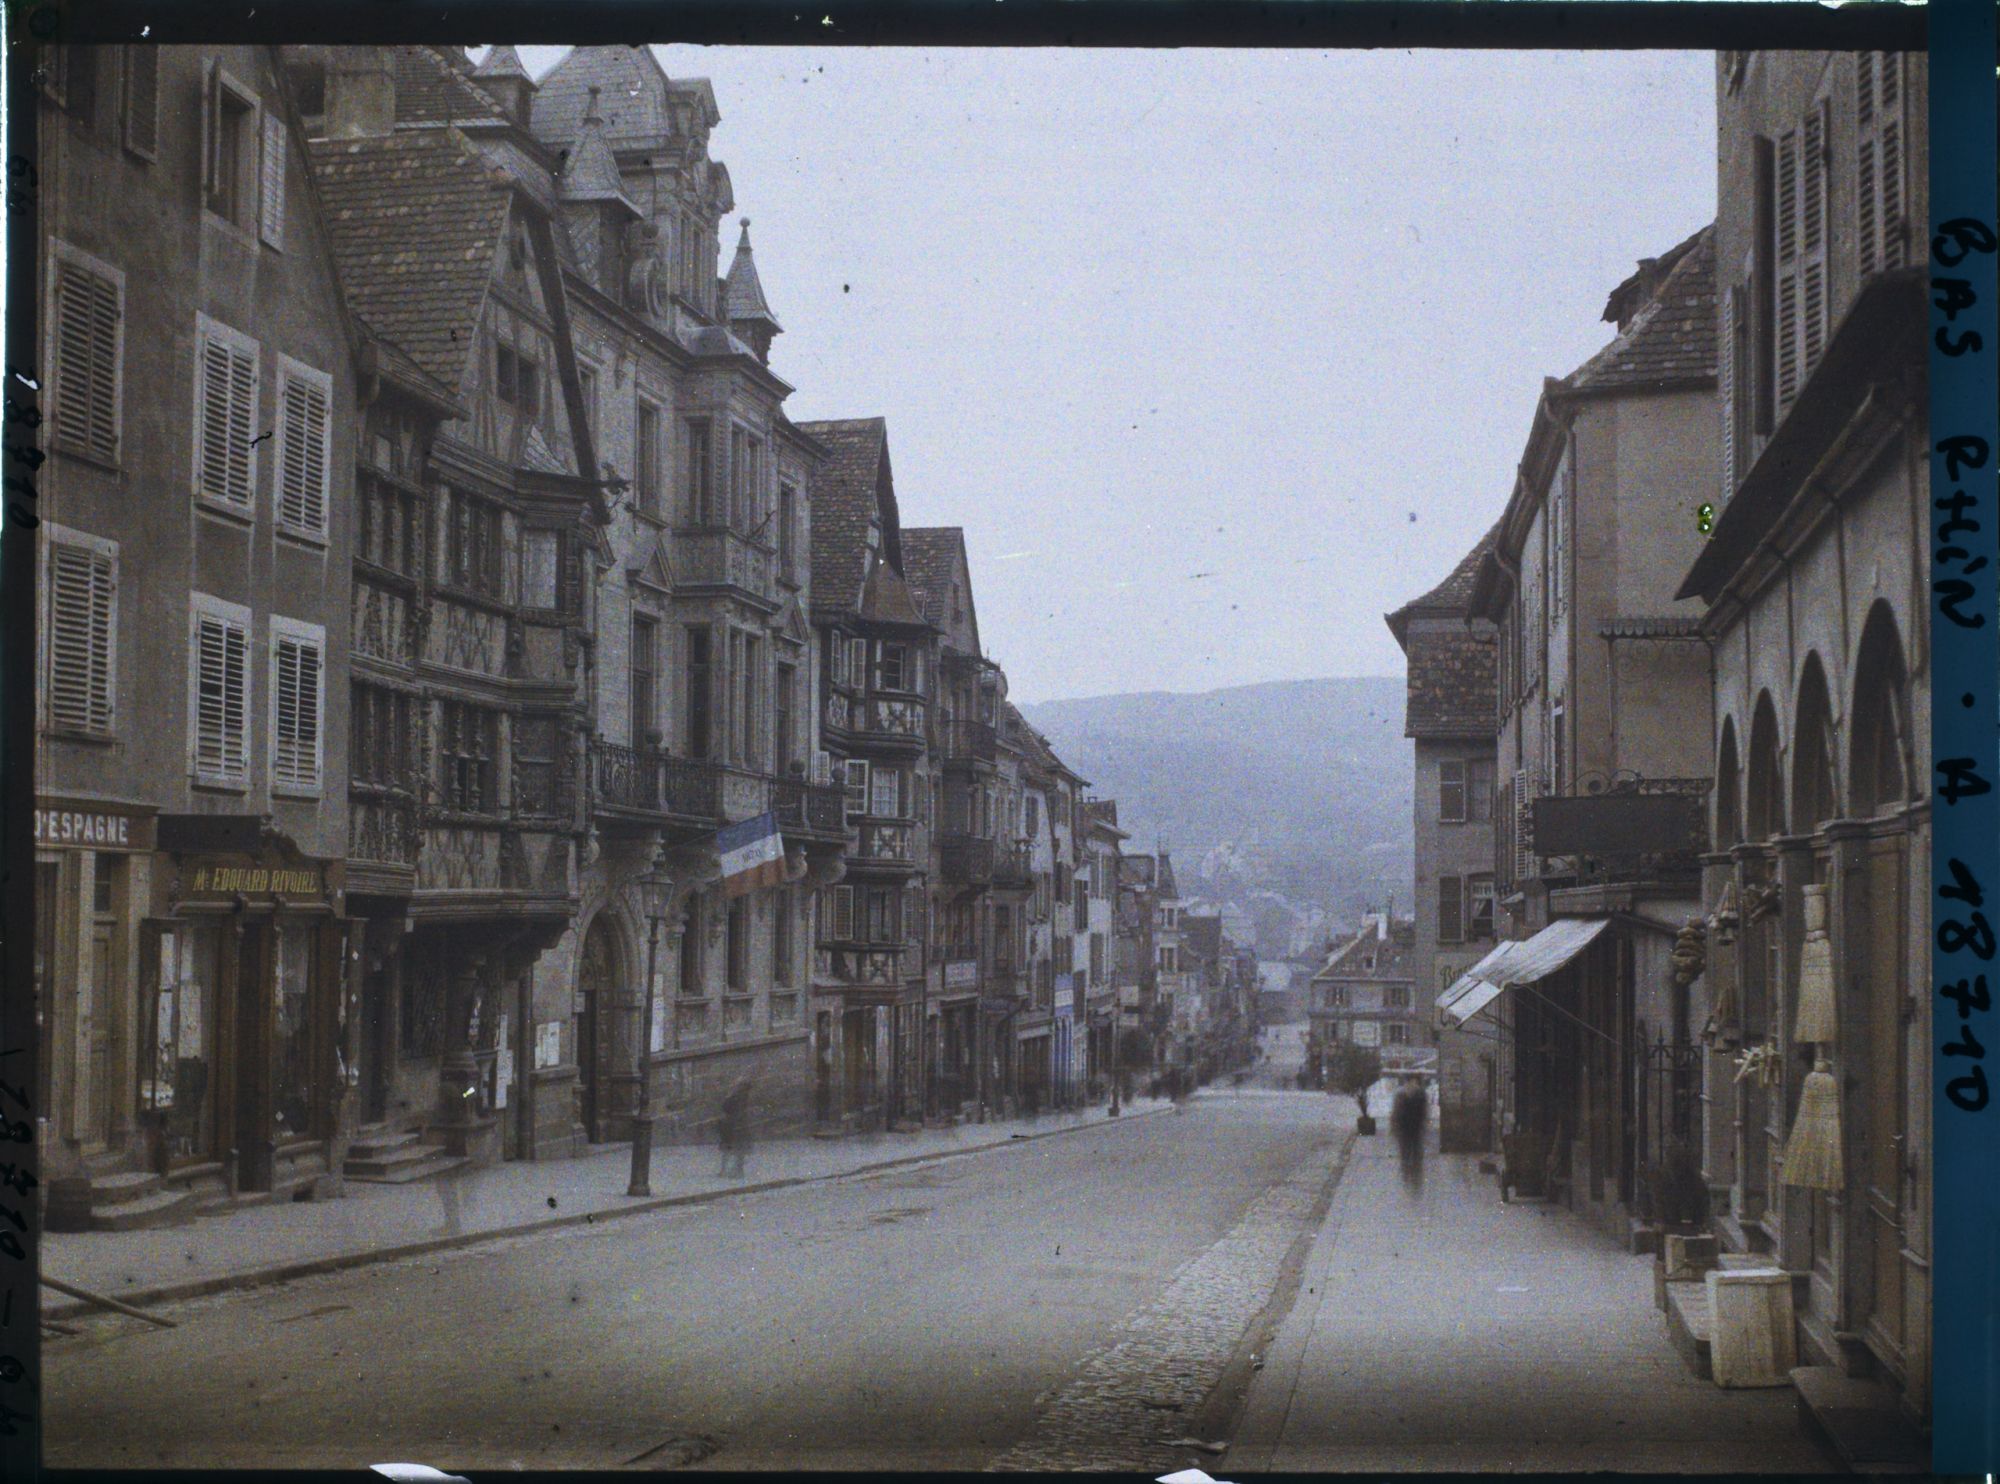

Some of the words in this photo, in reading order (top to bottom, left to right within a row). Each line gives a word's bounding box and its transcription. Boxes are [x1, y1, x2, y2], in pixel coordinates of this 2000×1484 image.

[1930, 216, 1998, 358] BAS
[1936, 757, 1992, 806] A
[212, 867, 267, 892] EDOUARD
[1937, 857, 1997, 1113] 18710
